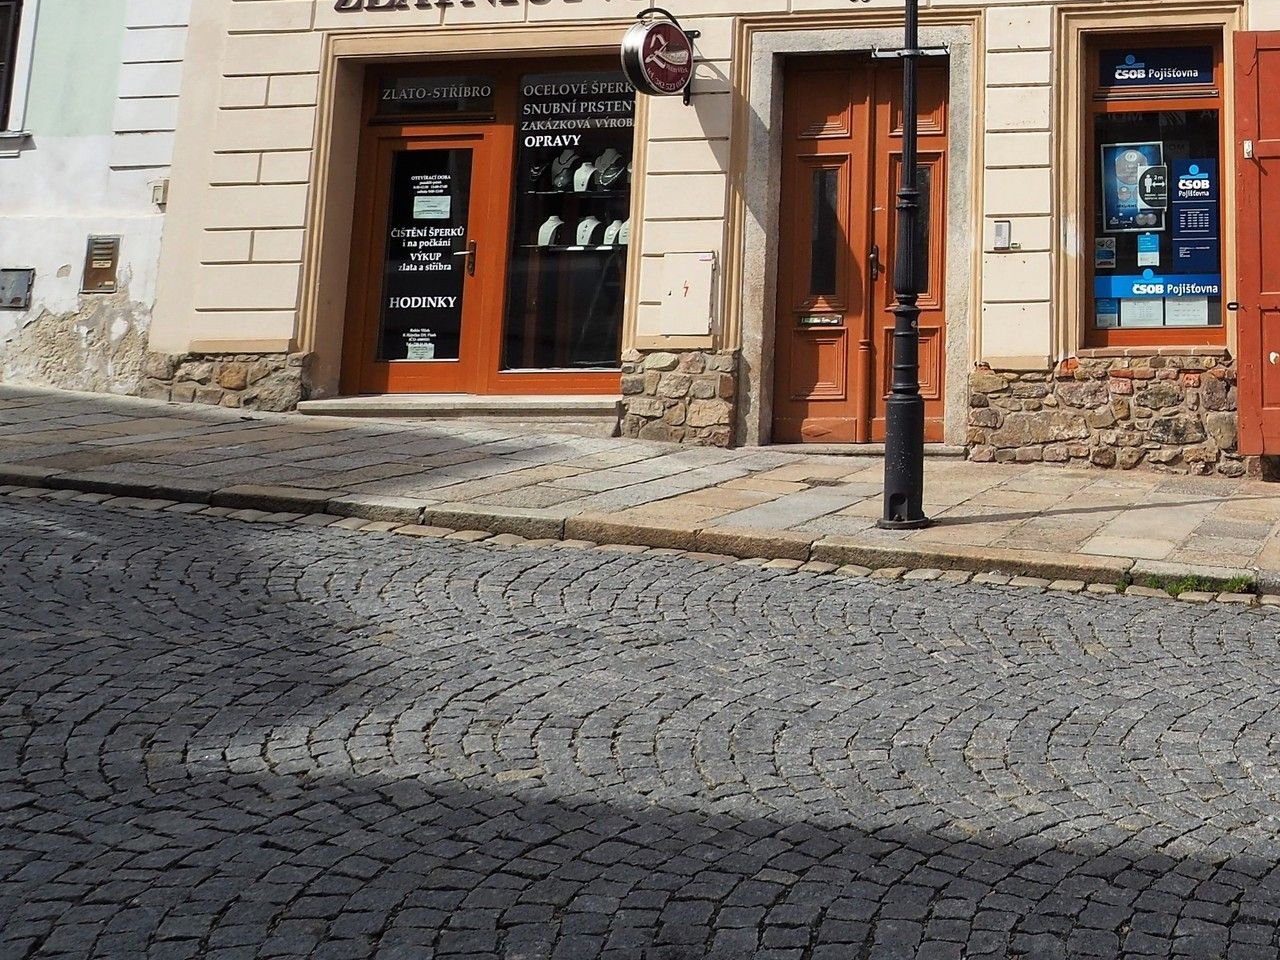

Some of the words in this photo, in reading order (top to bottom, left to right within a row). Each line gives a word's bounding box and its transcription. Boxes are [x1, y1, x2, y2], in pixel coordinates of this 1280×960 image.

[1114, 69, 1146, 79] ČSOB
[1148, 68, 1199, 80] Pojišťovna
[382, 84, 491, 100] ZLATO-STŘÍBRO
[523, 81, 588, 96] OCELOVÉ
[591, 80, 634, 95] ŠPERK
[523, 99, 577, 115] SNUBNÍ
[580, 100, 636, 113] PRSTEN
[521, 117, 591, 131] ZAKÁZKOVÁ
[524, 134, 581, 148] OPRAVY
[1178, 179, 1209, 190] ČSOB
[391, 227, 427, 238] ČIŠTĚNÍ
[429, 226, 464, 237] ŠPERKŮ
[419, 238, 451, 248] počkání
[410, 251, 442, 261] VÝKUP
[425, 262, 451, 271] stříbra
[1132, 283, 1164, 294] ČSOB
[1167, 282, 1218, 296] Pojišťovna
[389, 296, 457, 308] HODINKY
